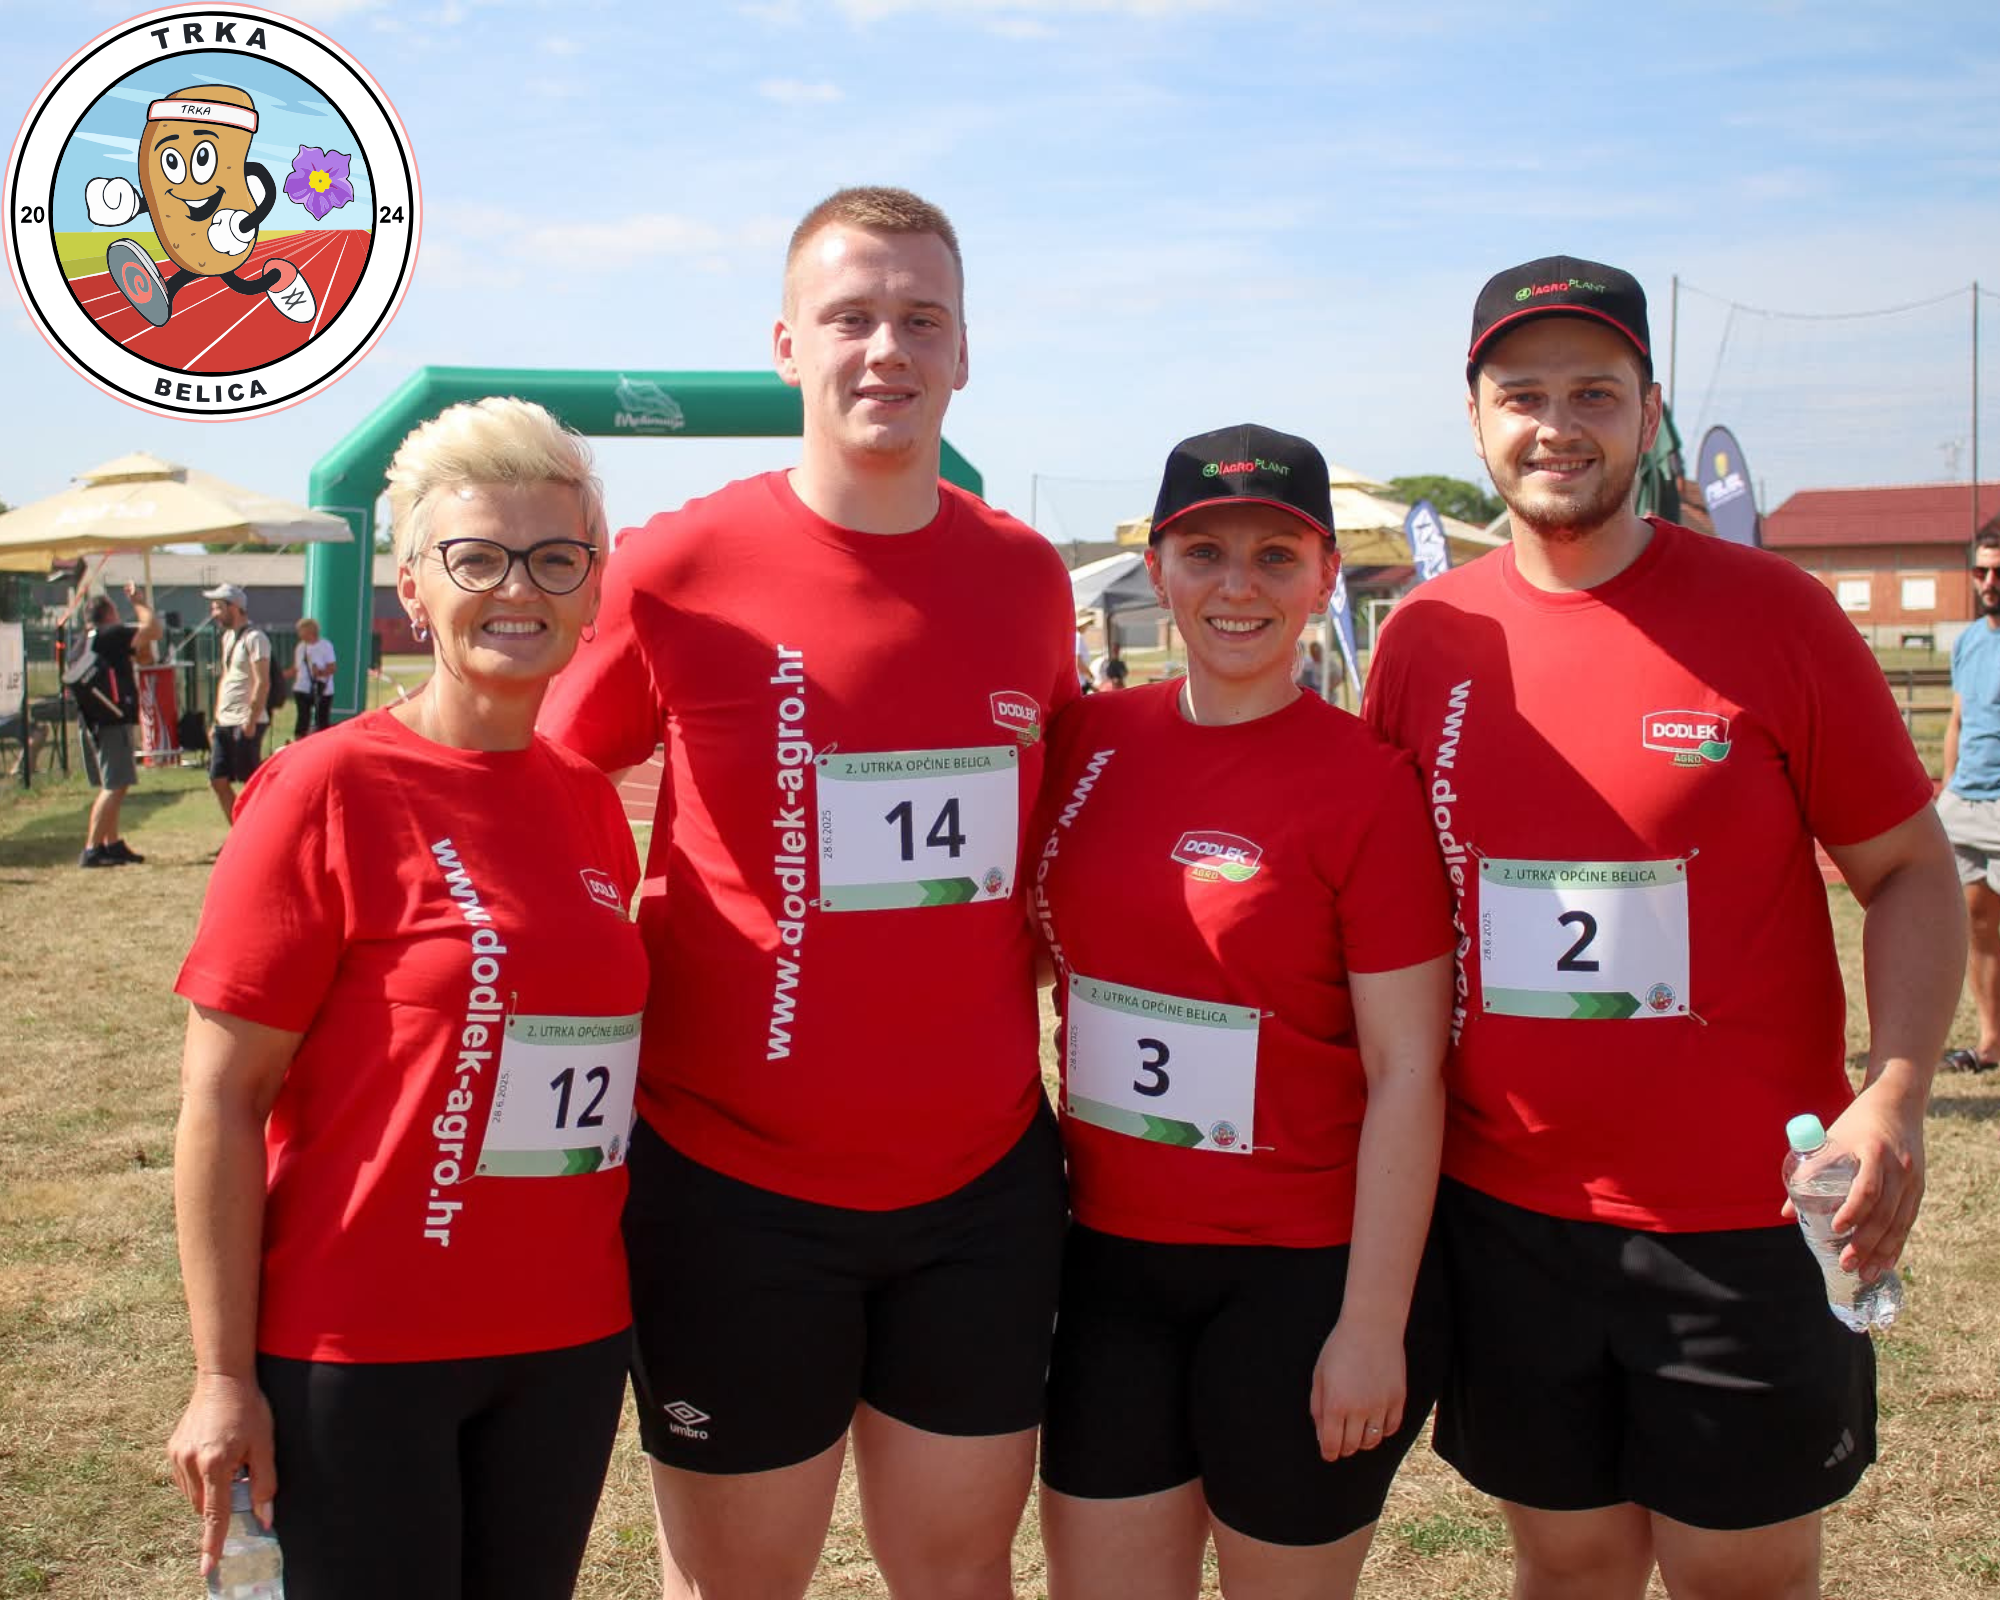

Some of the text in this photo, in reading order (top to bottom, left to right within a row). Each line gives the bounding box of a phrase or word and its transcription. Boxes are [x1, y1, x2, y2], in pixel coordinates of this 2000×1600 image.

[998, 702, 1037, 723] DODLEK
[1652, 723, 1719, 740] DODLEK
[846, 763, 857, 775] 2.
[861, 761, 903, 774] UTRKA
[954, 756, 991, 769] BELICA
[1674, 753, 1701, 763] AGRO
[884, 798, 966, 861] 14
[767, 644, 813, 1061] www.dodlek-agro.hr
[1183, 840, 1250, 864] DODLEK
[1192, 868, 1219, 880] AGRO
[1503, 868, 1514, 880] 2.
[1517, 869, 1556, 881] UTRKA
[1612, 870, 1656, 882] BELICA
[1557, 910, 1600, 972] 2
[1103, 990, 1139, 1008] UTRKA
[1187, 1006, 1228, 1024] BELICA
[424, 838, 507, 1247] www.dodlek-agro.hr
[527, 1025, 537, 1037] 2.
[540, 1025, 575, 1038] UTRKA
[1133, 1038, 1170, 1097] 3
[550, 1066, 610, 1129] 12
[670, 1422, 708, 1440] umbro
